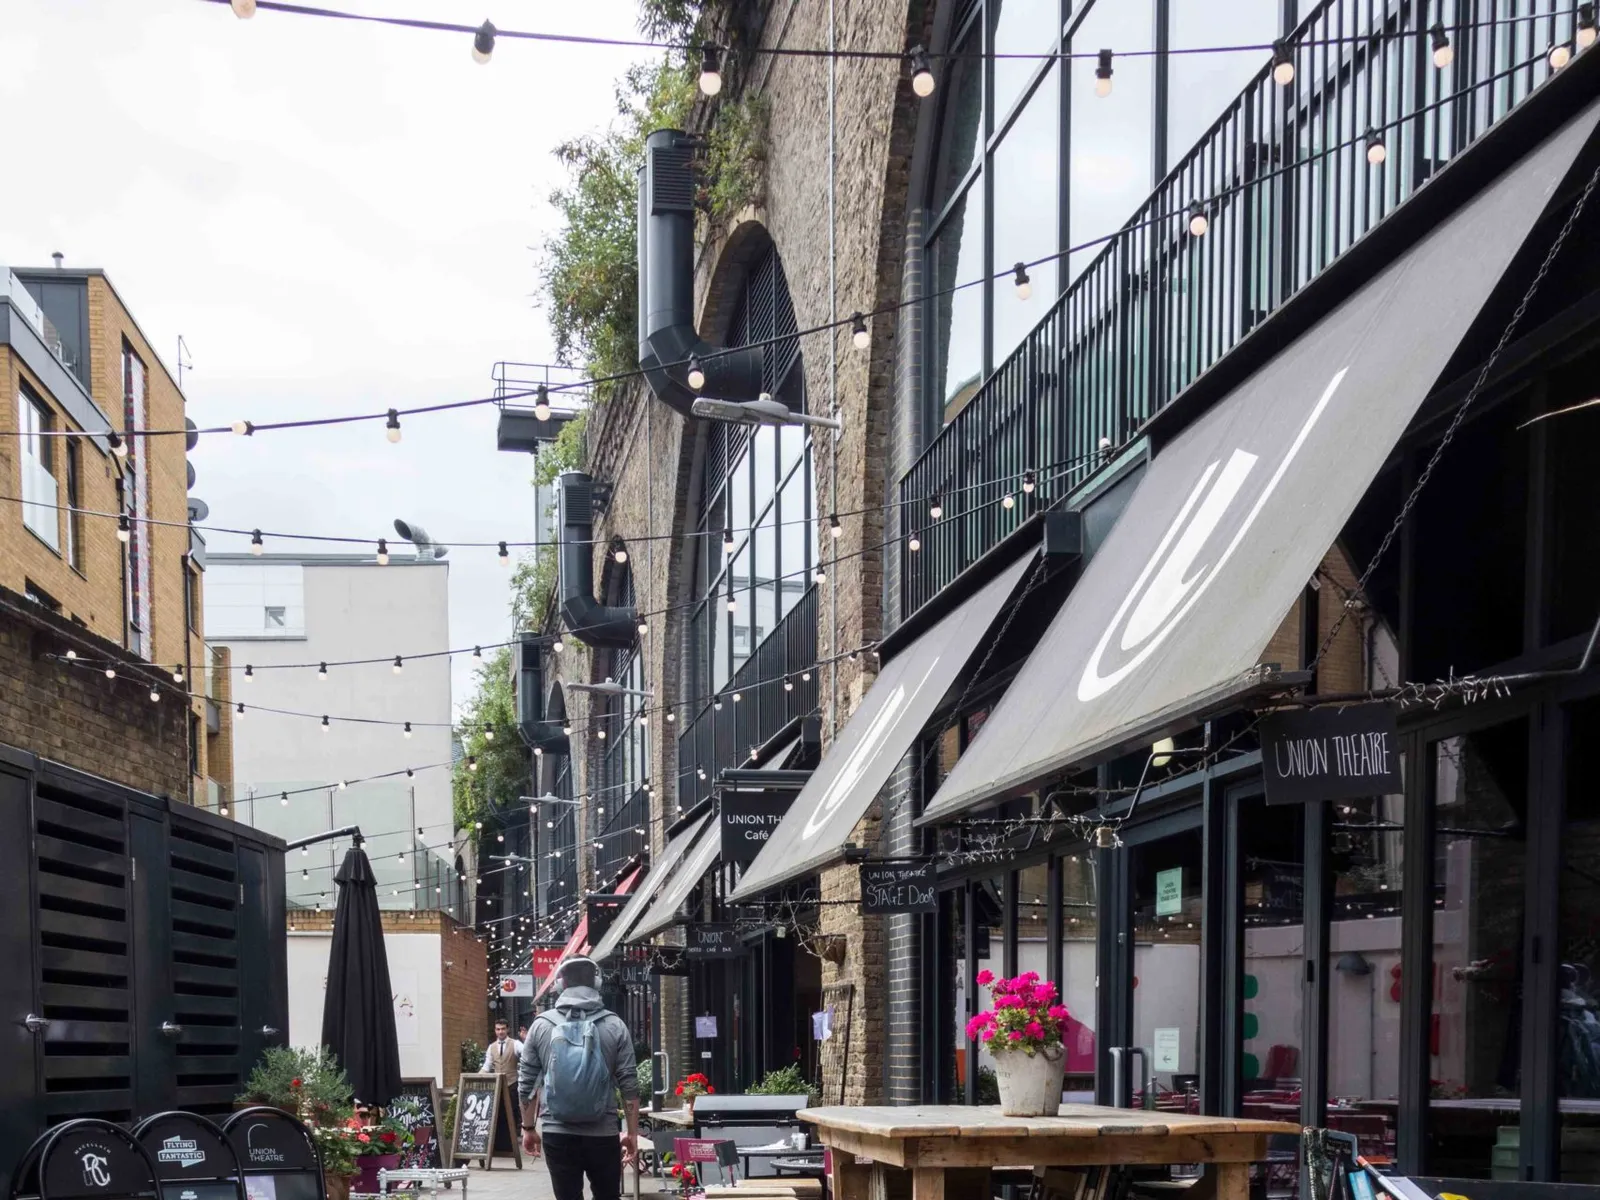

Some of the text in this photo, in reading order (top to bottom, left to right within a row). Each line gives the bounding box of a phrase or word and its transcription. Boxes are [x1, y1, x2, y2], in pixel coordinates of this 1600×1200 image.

[1275, 732, 1391, 778] UNION THEATRE
[727, 815, 784, 825] UNION TH
[745, 830, 769, 840] Café
[869, 870, 927, 880] UNION THEATRE
[867, 885, 905, 907] STAGE
[697, 931, 723, 943] UNION
[161, 1151, 202, 1160] FANTASTIC
[250, 1154, 285, 1162] THEATRE
